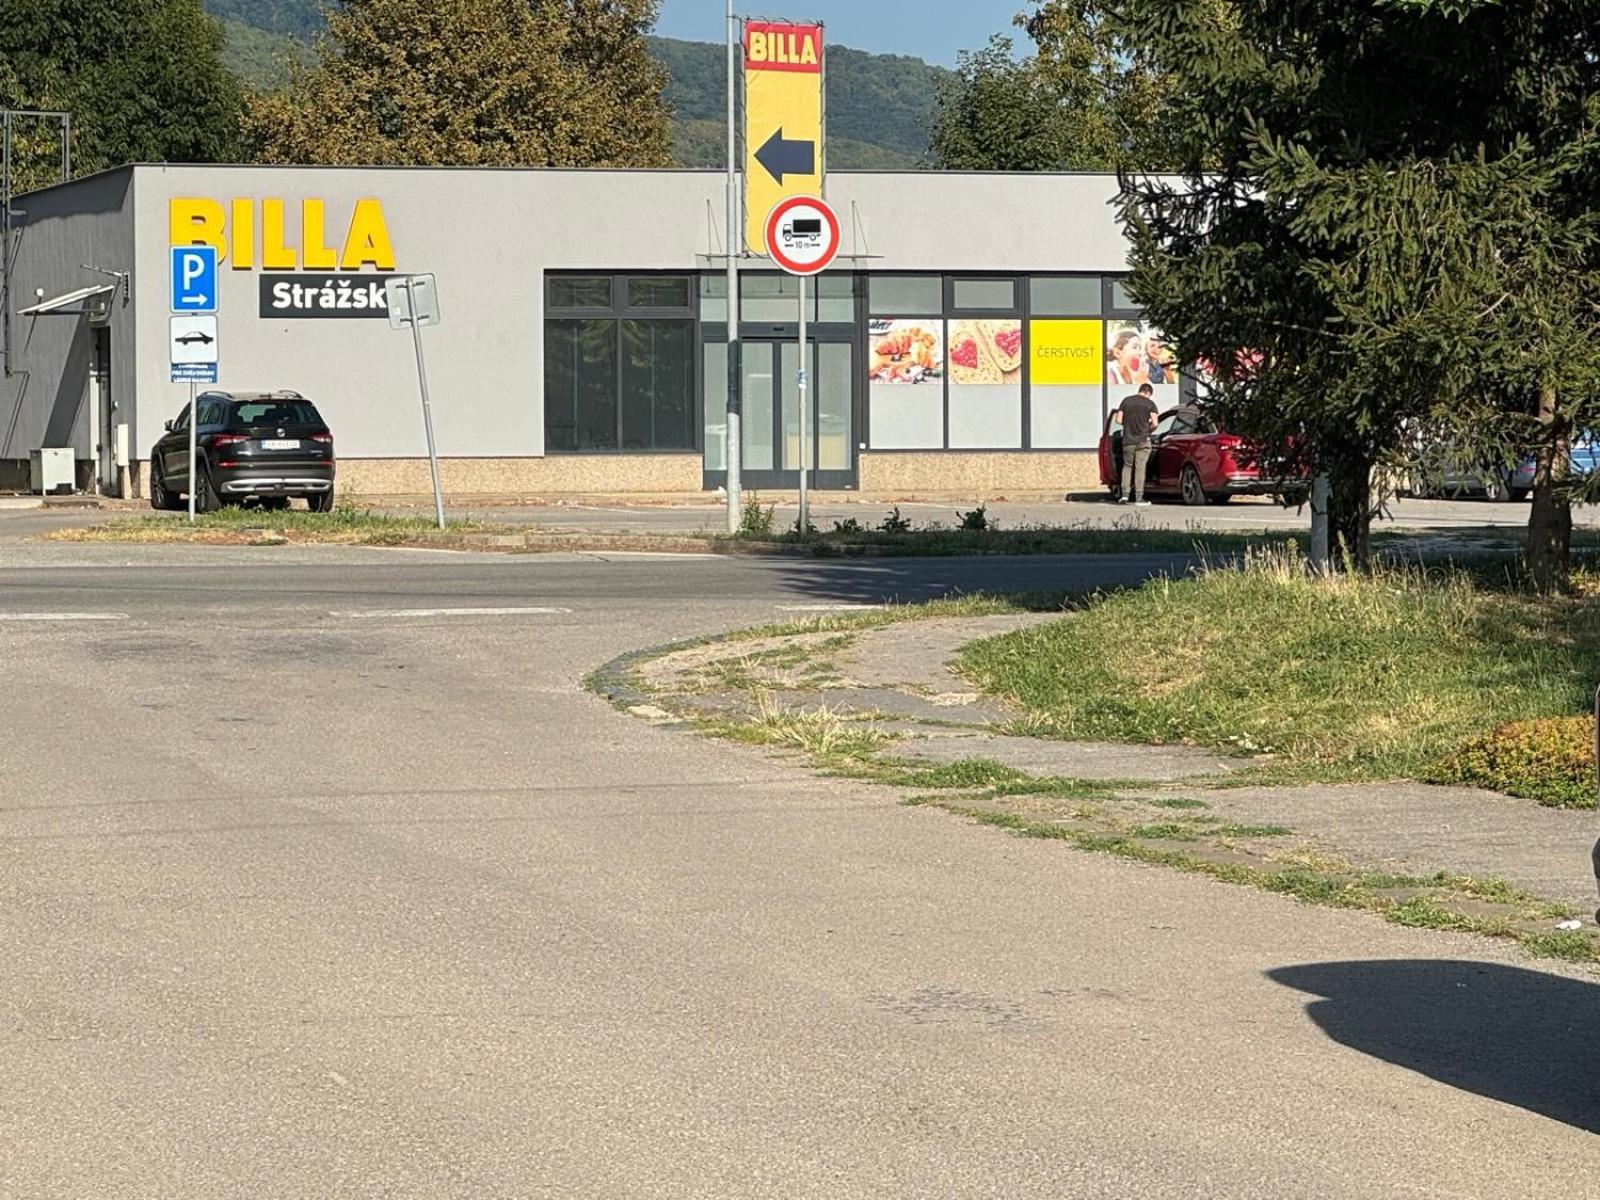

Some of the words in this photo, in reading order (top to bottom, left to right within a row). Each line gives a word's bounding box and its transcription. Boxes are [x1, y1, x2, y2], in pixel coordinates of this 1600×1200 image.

[749, 31, 818, 64] BILLA
[169, 197, 396, 271] BILLA
[795, 241, 803, 249] 10
[183, 253, 205, 290] P
[272, 280, 388, 309] Strážsk
